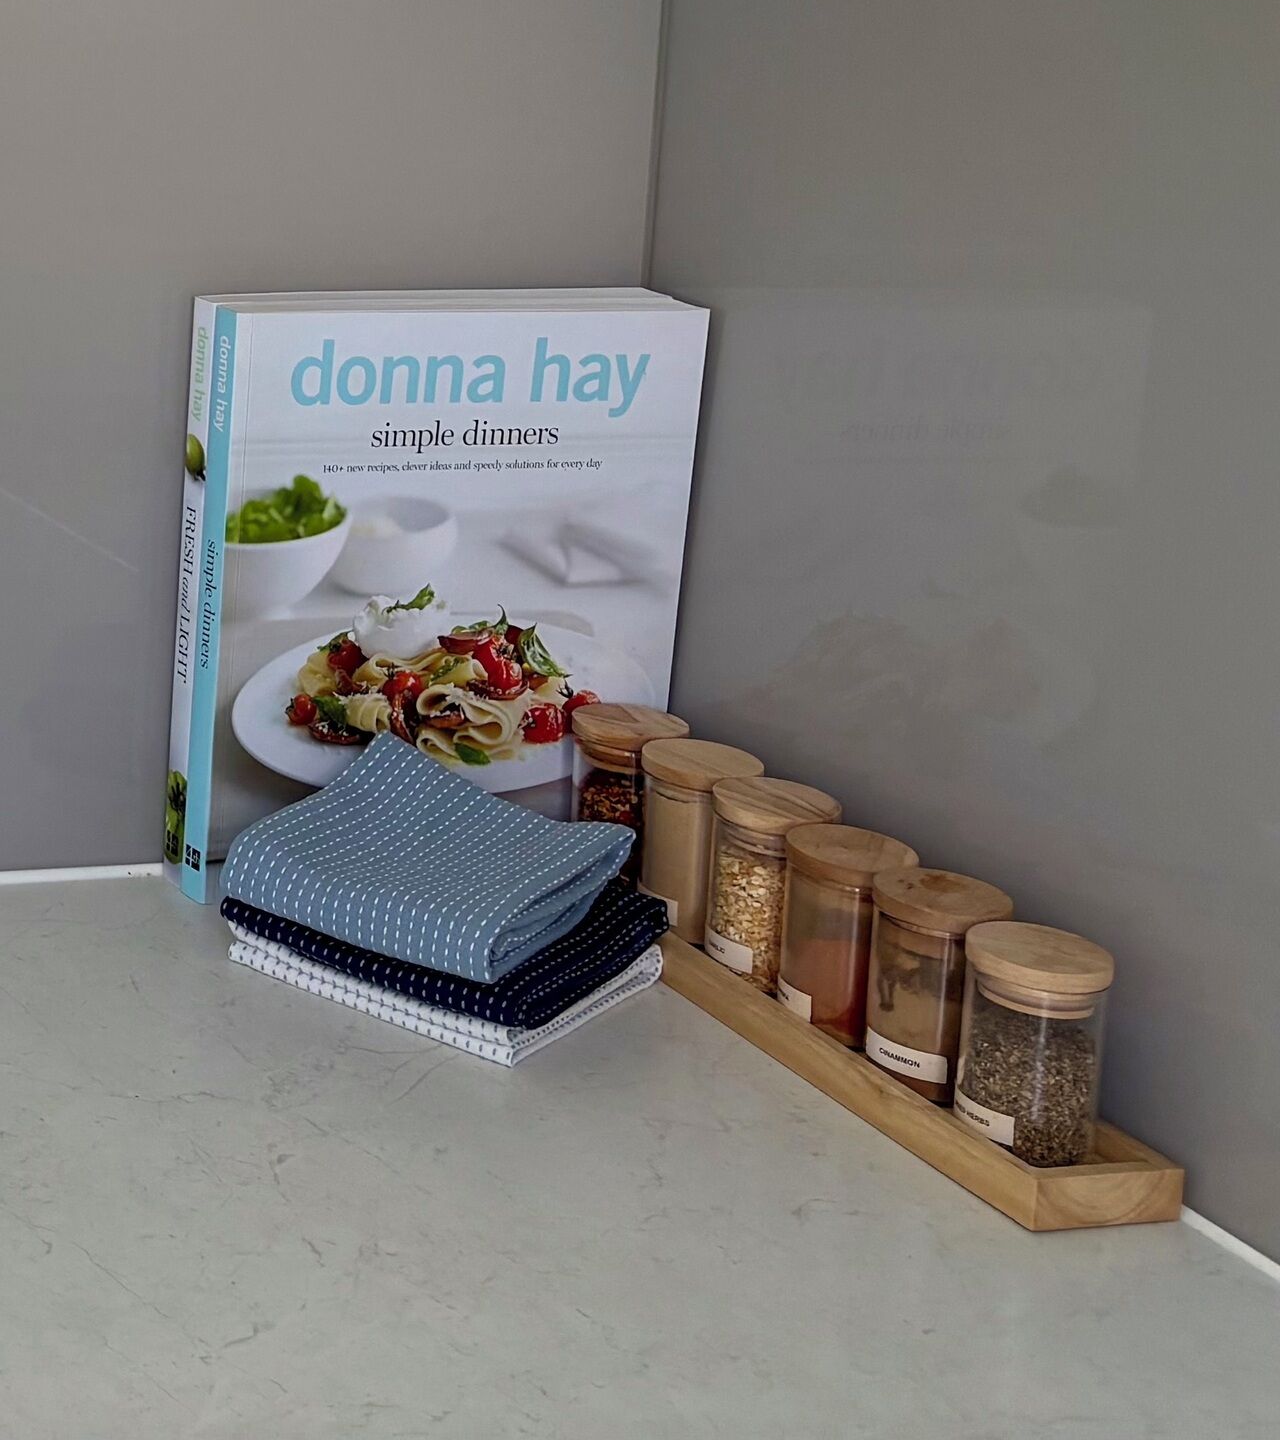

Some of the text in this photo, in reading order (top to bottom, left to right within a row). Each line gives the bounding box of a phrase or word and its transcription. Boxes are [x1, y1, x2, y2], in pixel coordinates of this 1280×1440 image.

[192, 326, 209, 422] donna hay
[213, 335, 231, 432] donna hay
[290, 337, 651, 418] donna hay
[322, 458, 603, 475] 140+ new recipes, clever ideas and speedy solutions for every day
[371, 420, 560, 454] simple dinners
[176, 506, 197, 684] FRESH and LIGHT
[200, 539, 219, 670] simple dinners
